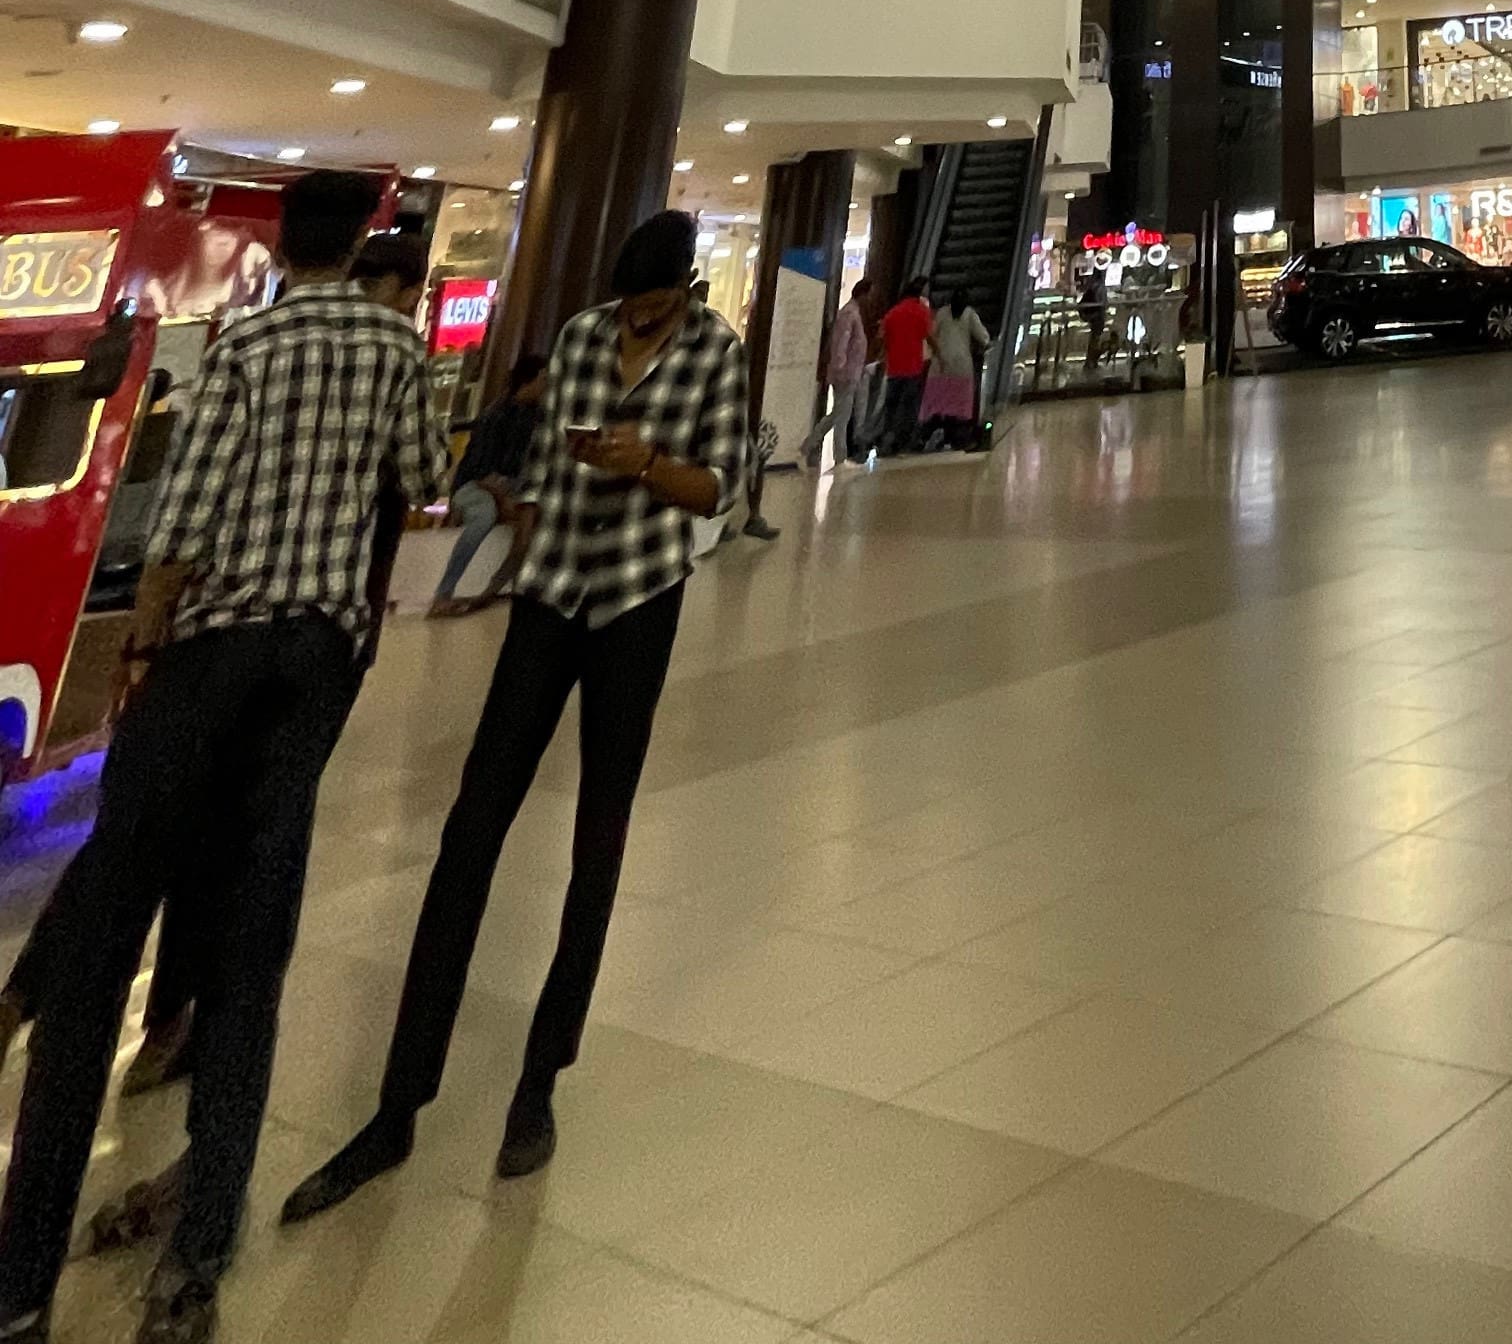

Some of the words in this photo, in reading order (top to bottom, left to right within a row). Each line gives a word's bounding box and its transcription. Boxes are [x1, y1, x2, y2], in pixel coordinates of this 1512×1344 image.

[1082, 232, 1126, 250] Cookie
[1134, 228, 1164, 246] Man
[0, 248, 94, 301] BUS
